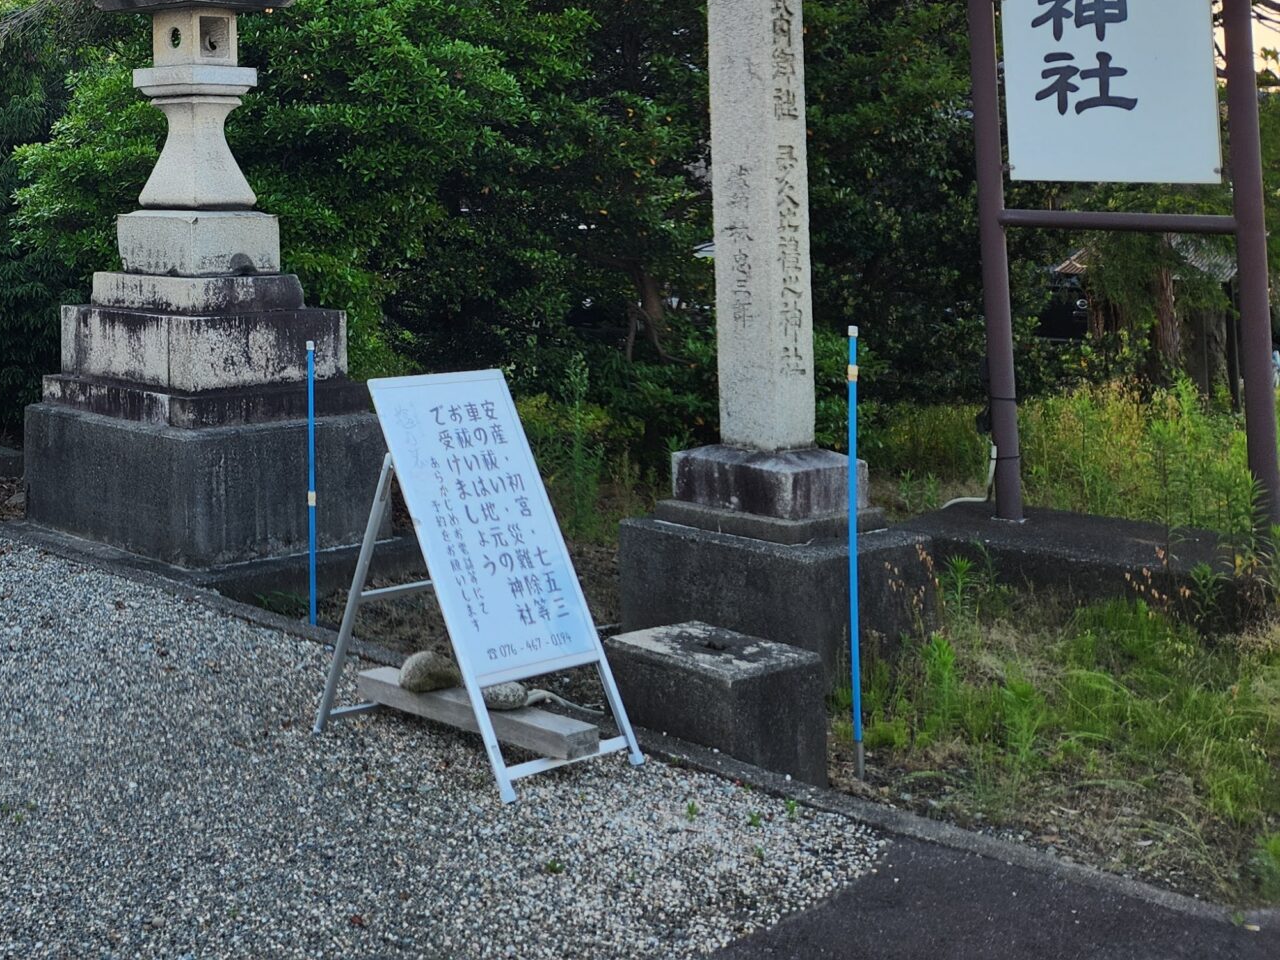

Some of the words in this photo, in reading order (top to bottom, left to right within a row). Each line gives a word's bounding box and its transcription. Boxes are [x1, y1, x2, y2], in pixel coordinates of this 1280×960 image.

[429, 406, 497, 577] で受けましょう
[448, 403, 537, 627] お祓いは地元の神社
